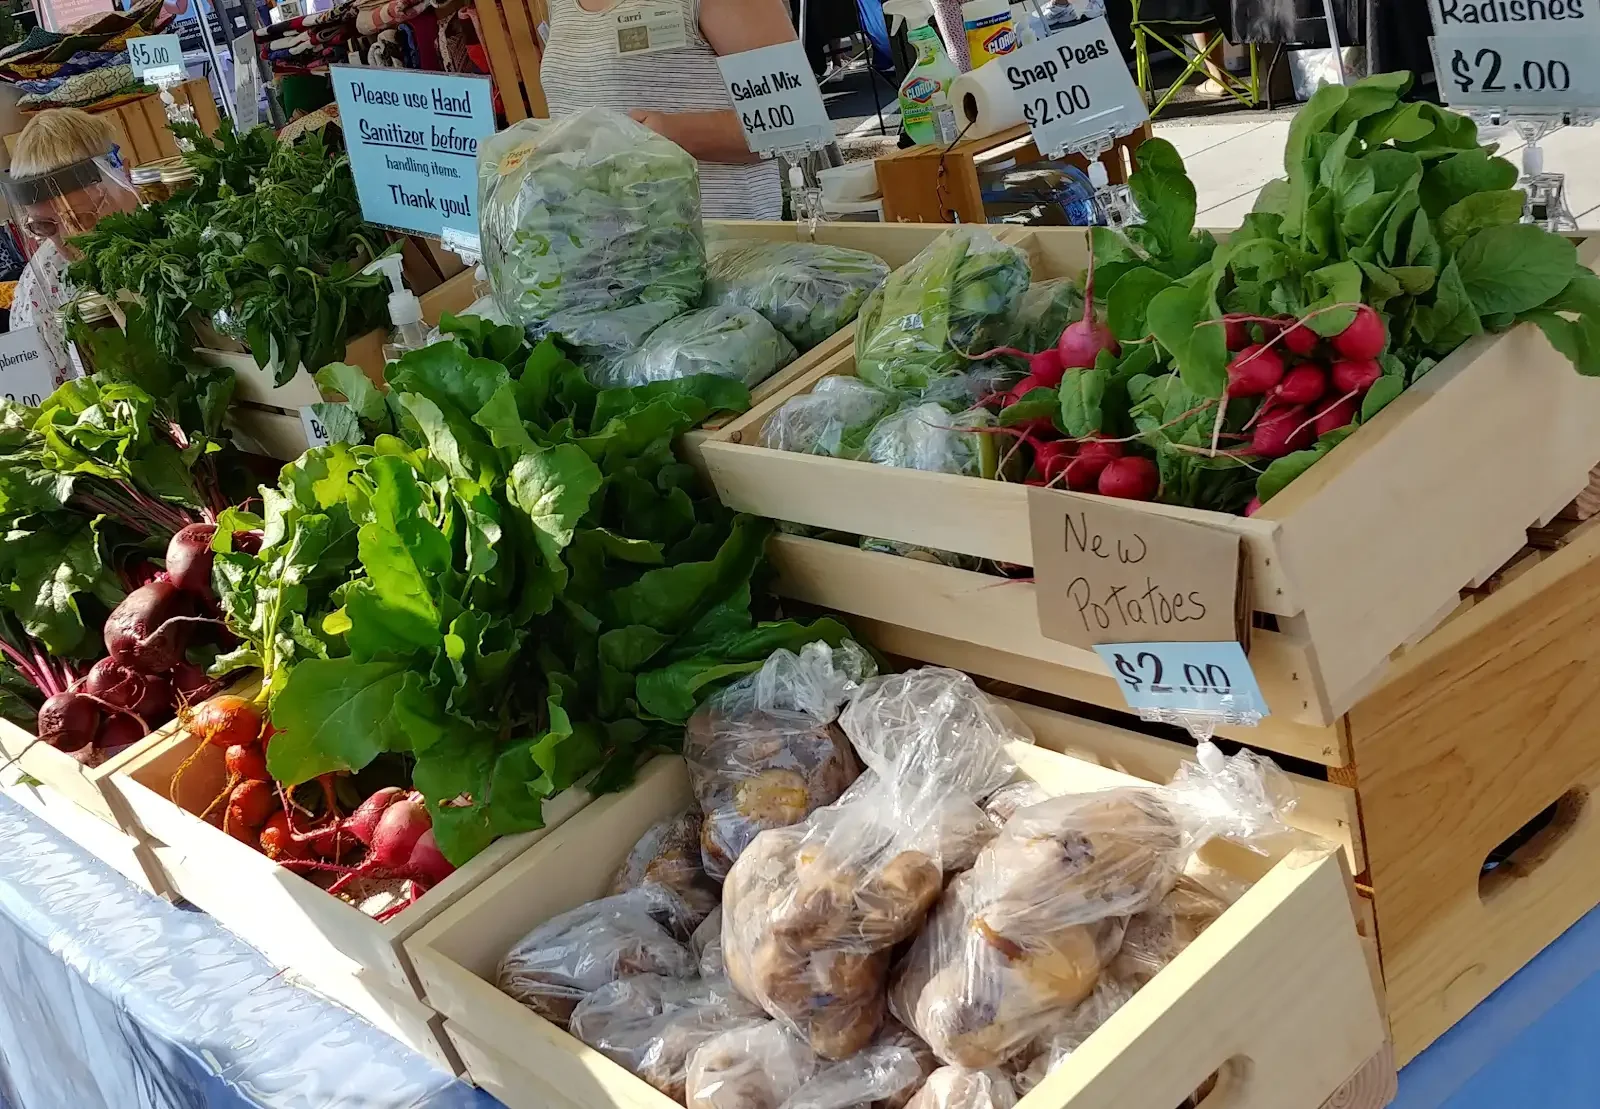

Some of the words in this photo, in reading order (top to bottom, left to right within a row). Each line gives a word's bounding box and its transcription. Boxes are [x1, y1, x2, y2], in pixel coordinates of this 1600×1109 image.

[617, 12, 642, 23] Carri
[1438, 0, 1584, 25] Radishes
[132, 43, 169, 66] $5.00
[988, 30, 1017, 54] CLORO
[1007, 60, 1058, 90] Snap
[1057, 39, 1109, 69] Peas
[1452, 48, 1569, 93] $2.00
[350, 81, 399, 107] Please
[403, 92, 428, 110] use
[431, 88, 472, 114] Hand
[731, 75, 772, 101] Salad
[770, 71, 802, 92] Mix
[906, 79, 937, 99] CLOROX
[743, 104, 794, 133] $4.00
[1023, 84, 1090, 129] $2.00
[359, 118, 425, 147] Sanitizer
[431, 125, 478, 153] before
[385, 154, 429, 178] handling
[431, 162, 461, 179] items.
[388, 184, 437, 210] Thank
[440, 194, 471, 219] you!
[1064, 512, 1147, 564] New
[1066, 576, 1207, 632] Potatoes
[1113, 651, 1232, 695] $2.00
